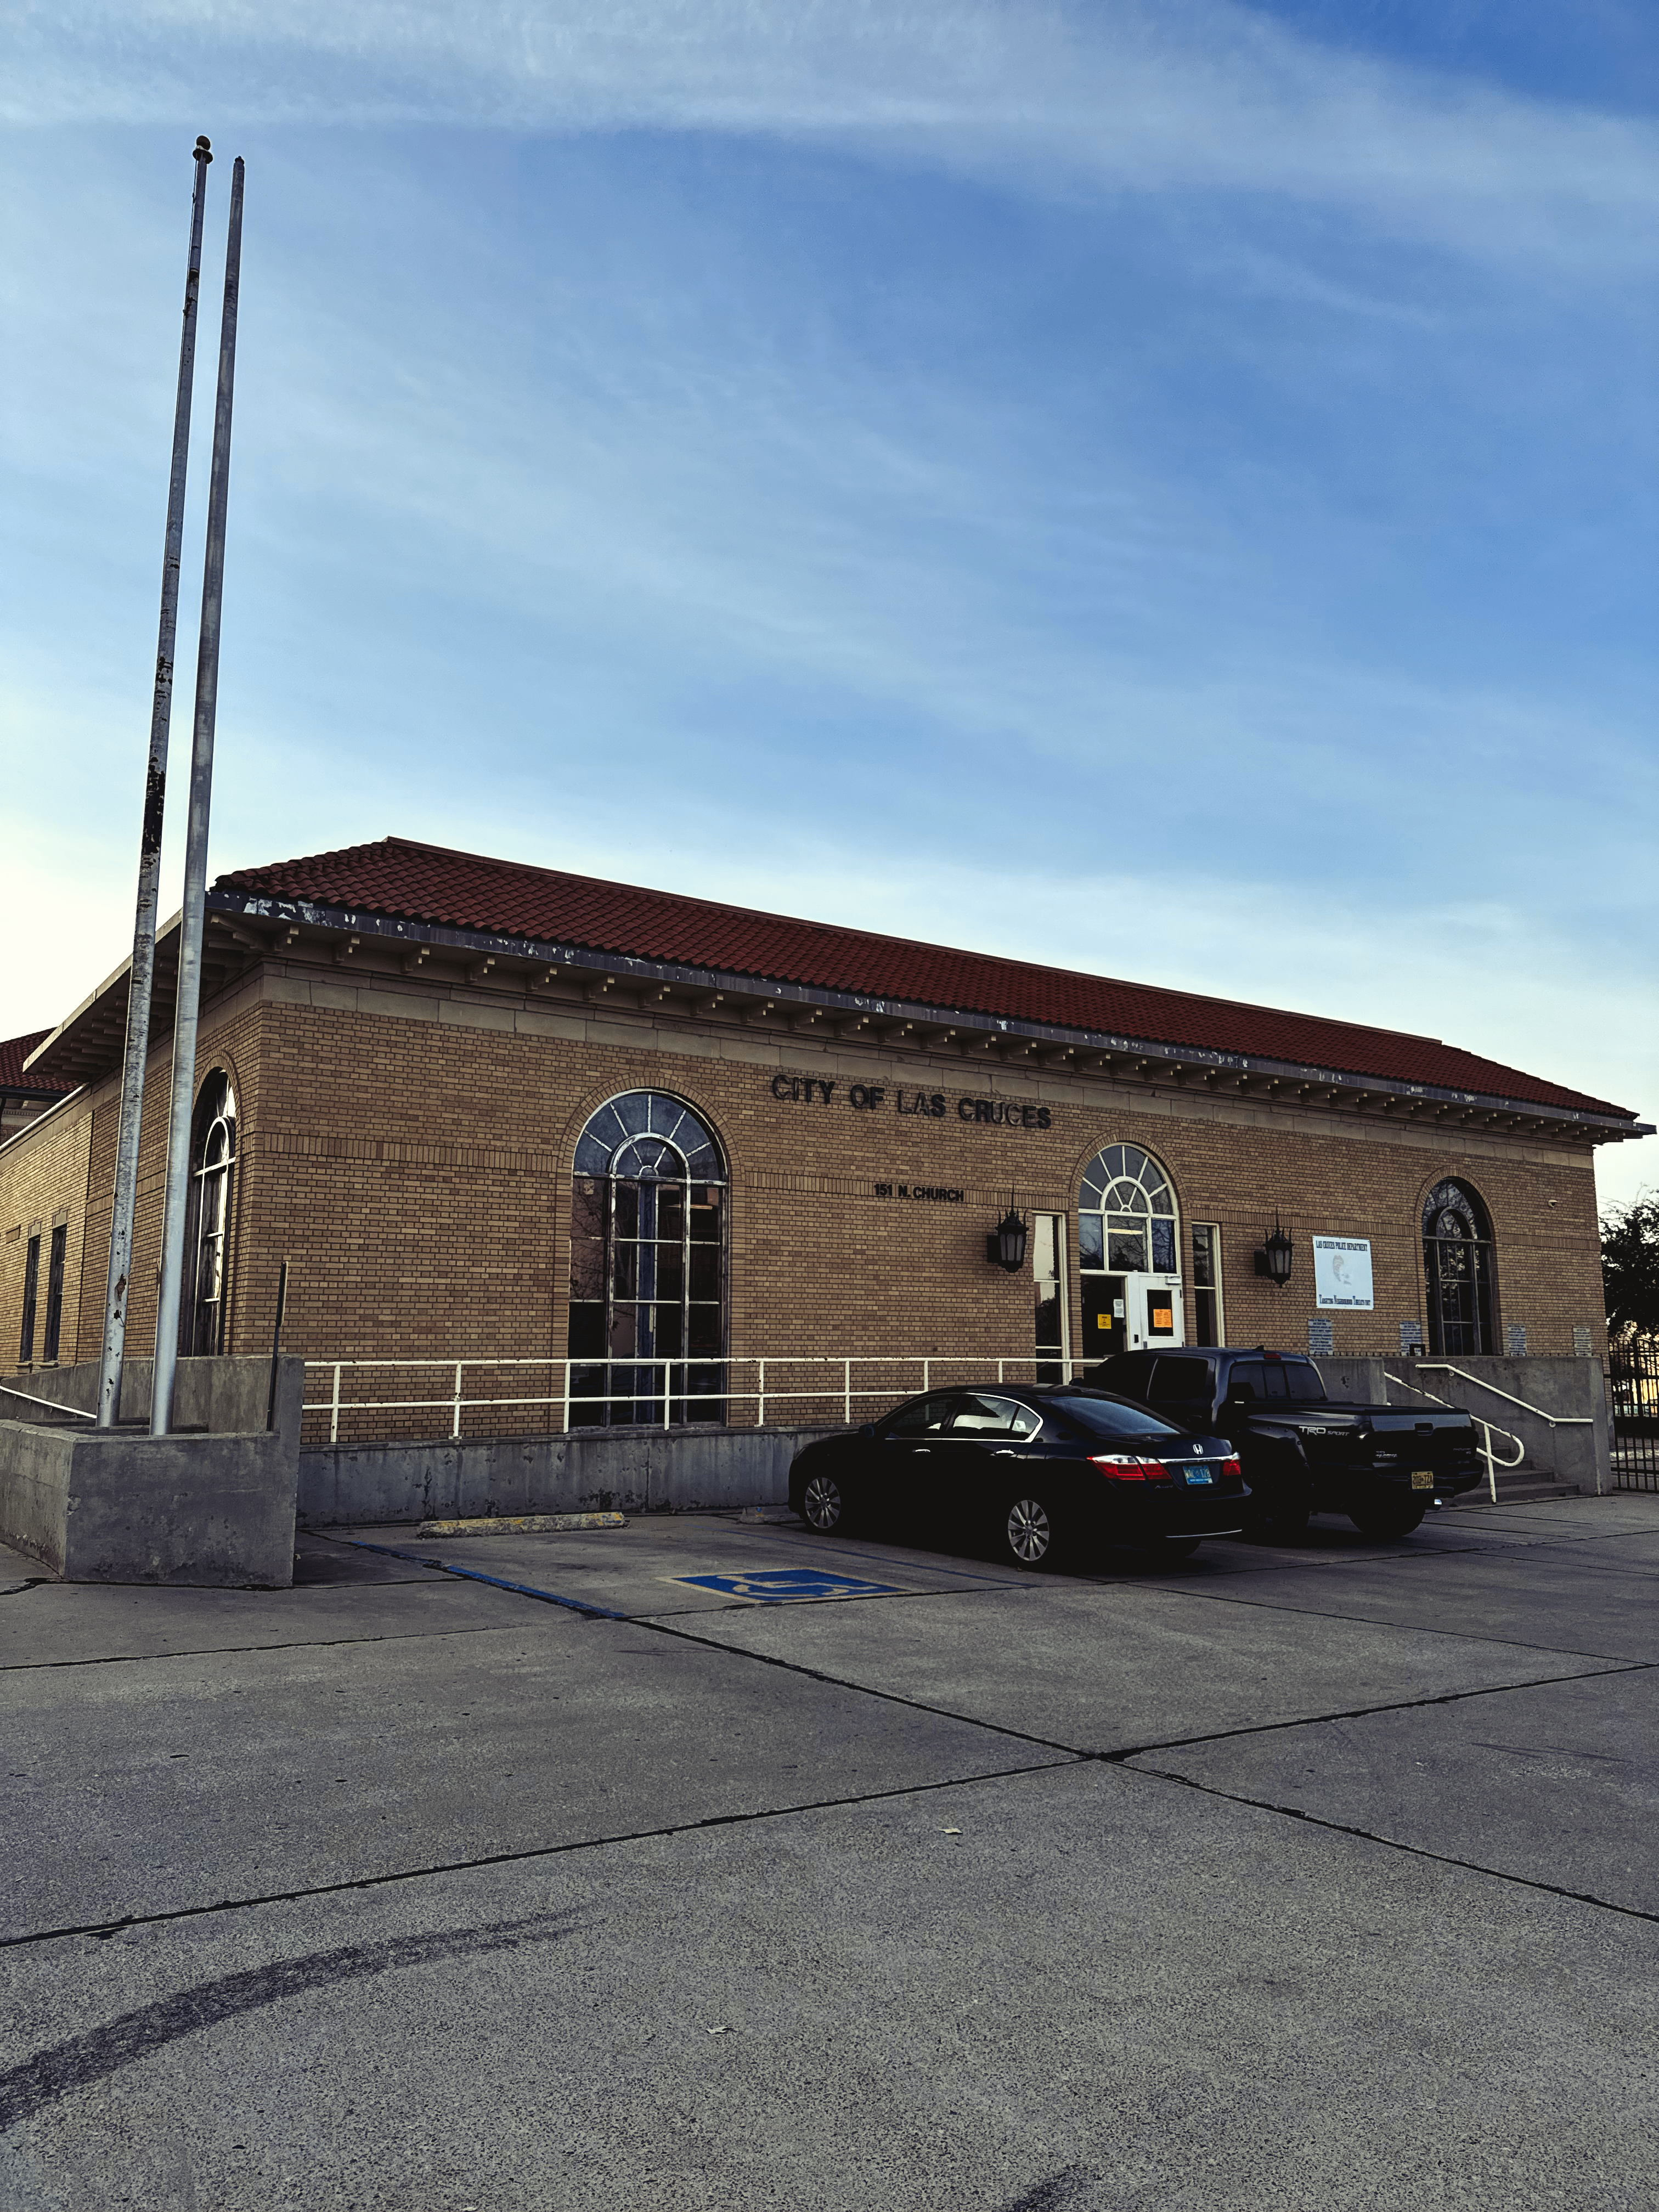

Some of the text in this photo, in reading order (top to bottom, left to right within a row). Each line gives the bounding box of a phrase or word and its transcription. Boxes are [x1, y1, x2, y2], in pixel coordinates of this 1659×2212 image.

[772, 1074, 1051, 1128] CITY OF LAS CRUCES
[874, 1183, 964, 1201] 151 N. CHURCH
[1299, 1426, 1326, 1436] TRD
